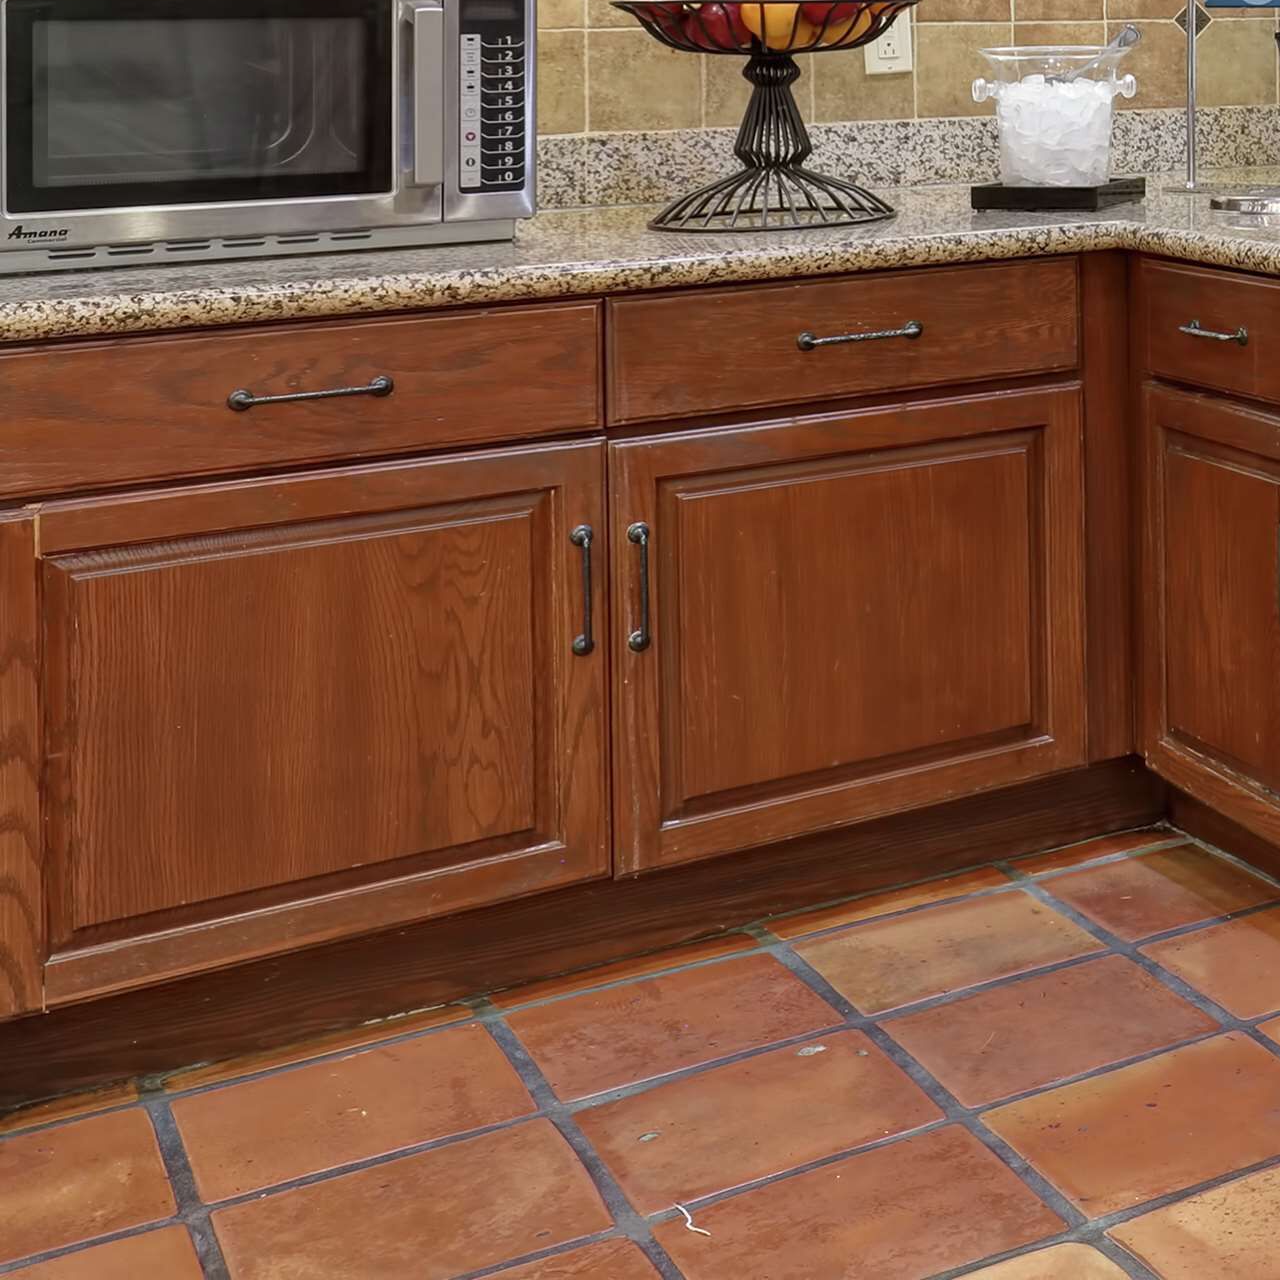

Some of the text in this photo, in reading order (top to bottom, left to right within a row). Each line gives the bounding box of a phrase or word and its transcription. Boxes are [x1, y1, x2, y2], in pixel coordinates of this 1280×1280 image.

[504, 35, 513, 45] 1
[504, 50, 513, 61] 2
[504, 65, 513, 76] 3
[504, 80, 513, 91] 4
[504, 95, 513, 106] 5
[504, 110, 513, 121] 6
[504, 125, 513, 136] 7
[504, 140, 513, 151] 8
[504, 155, 513, 166] 9
[504, 170, 513, 181] 0
[7, 225, 69, 240] Amana
